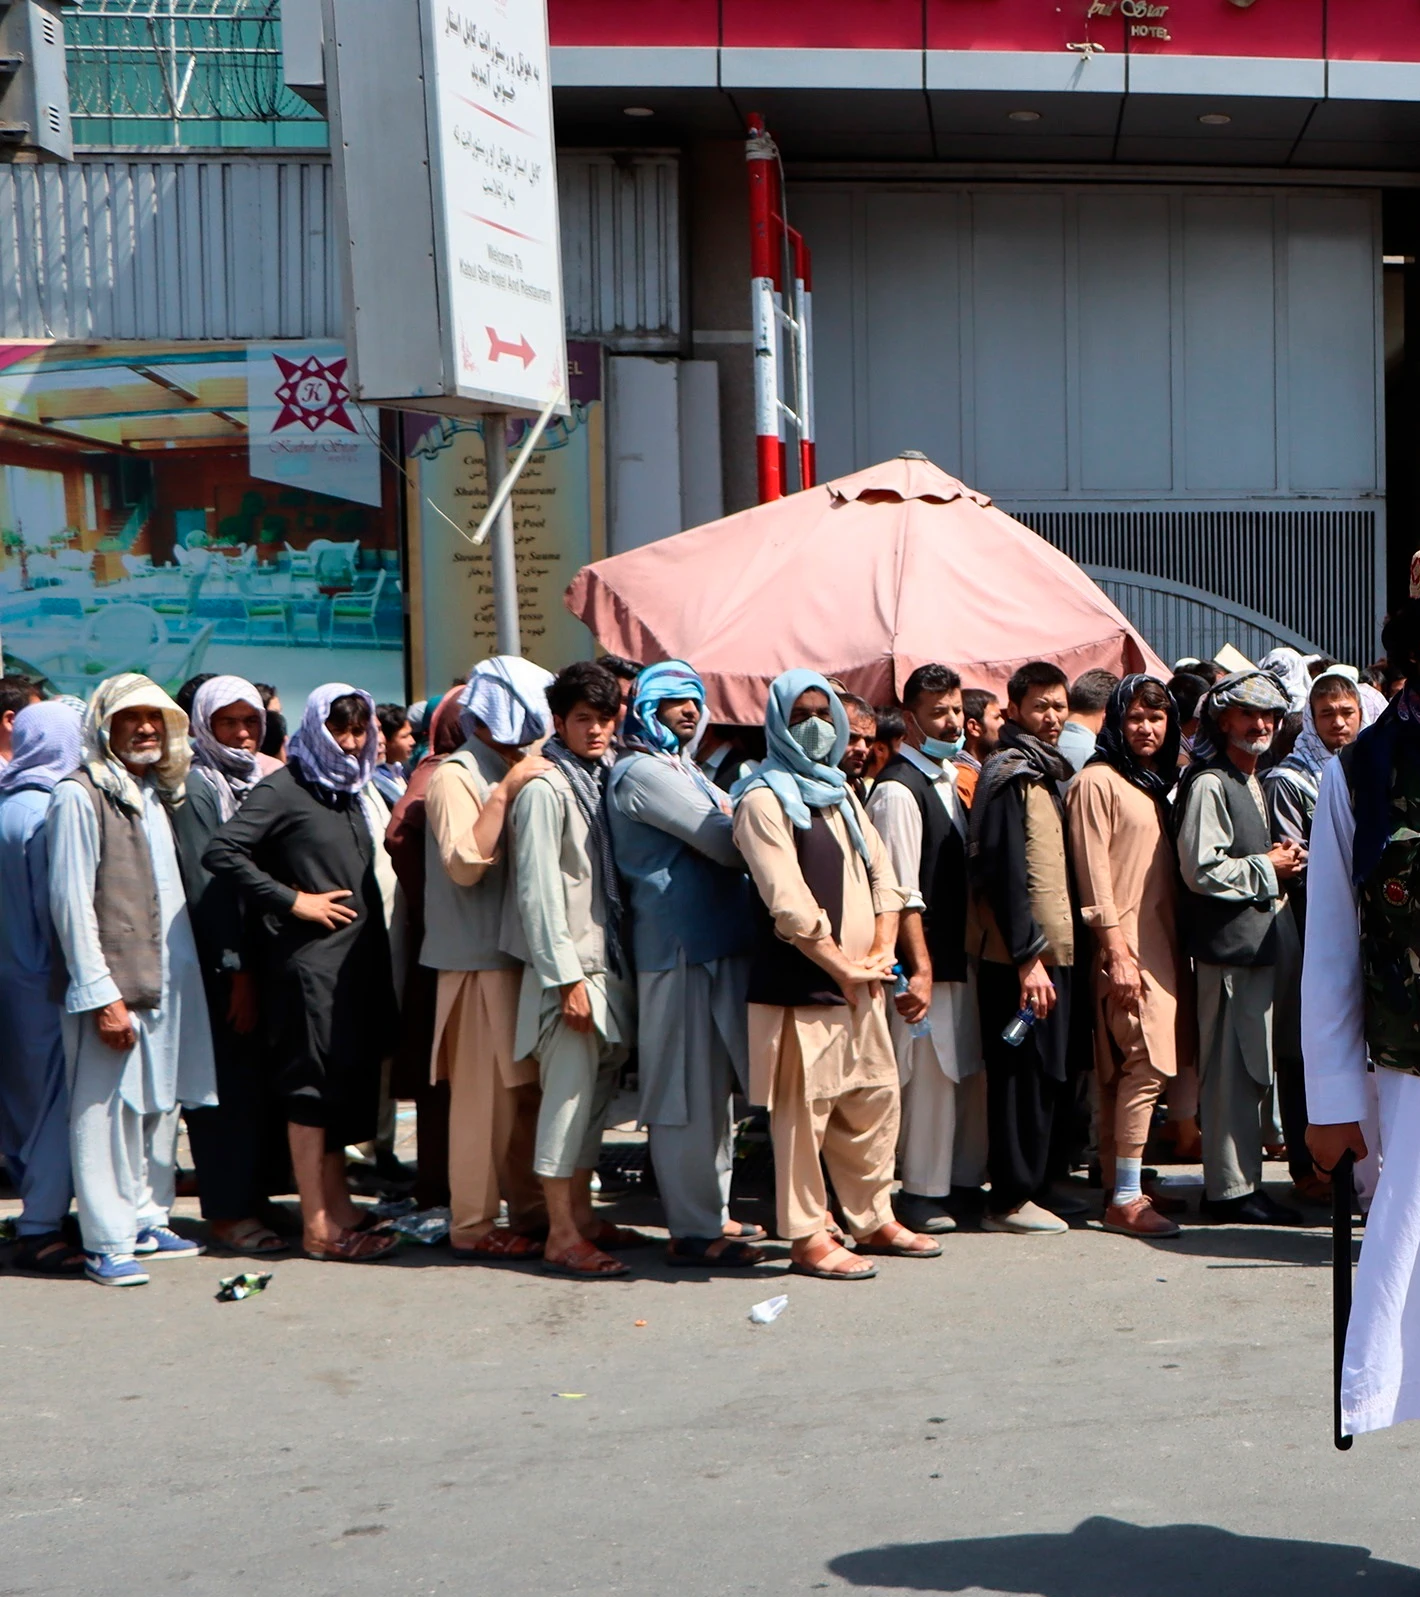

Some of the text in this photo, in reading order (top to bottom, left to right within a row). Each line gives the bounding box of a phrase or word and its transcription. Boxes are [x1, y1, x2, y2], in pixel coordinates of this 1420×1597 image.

[1131, 25, 1171, 41] HOTEL
[470, 62, 516, 106] خوش آمدید
[486, 243, 515, 271] Welcome
[459, 257, 553, 304] Kabul Star Hotel And Restaurant
[302, 382, 323, 402] K
[523, 519, 545, 528] Pool
[528, 551, 561, 561] Sauna
